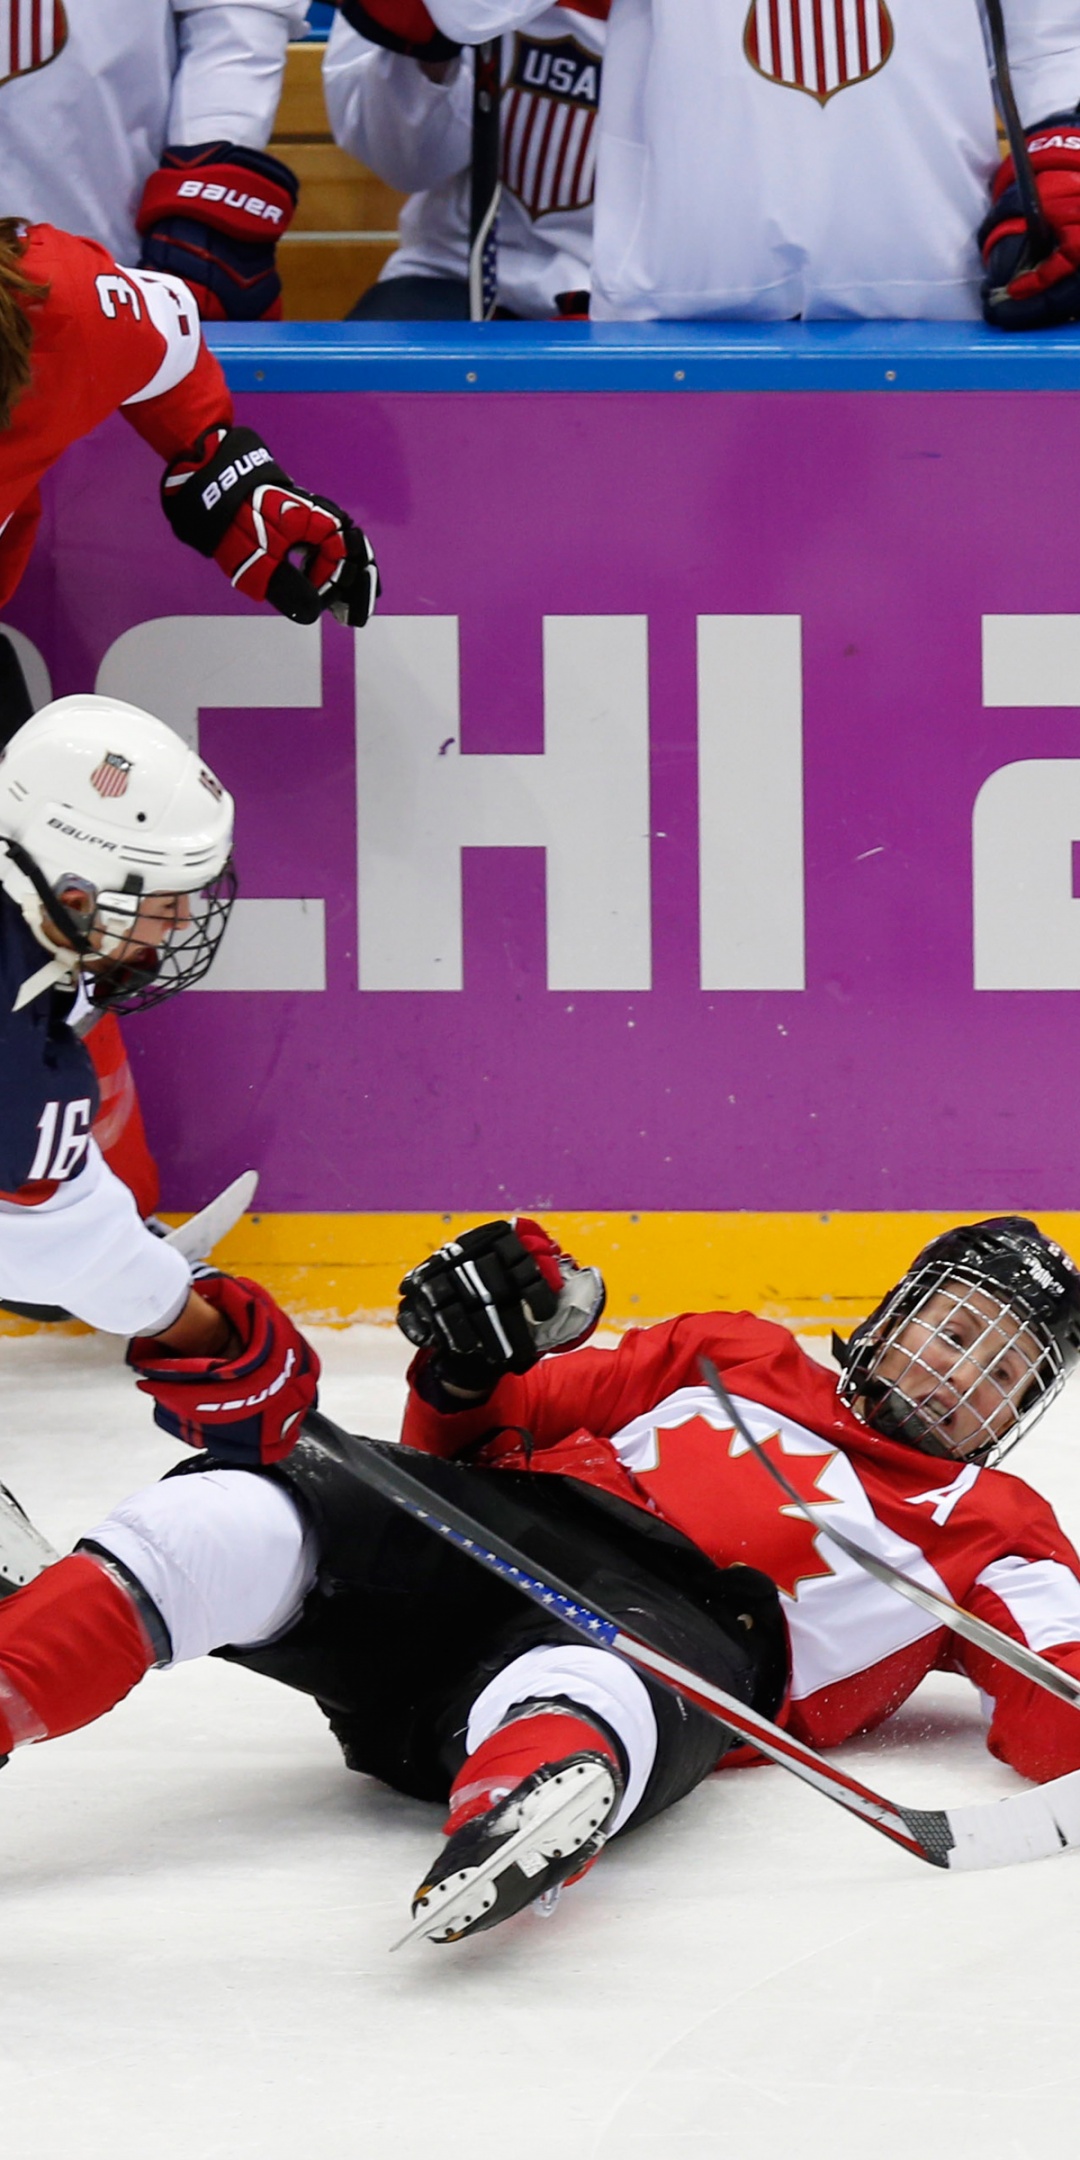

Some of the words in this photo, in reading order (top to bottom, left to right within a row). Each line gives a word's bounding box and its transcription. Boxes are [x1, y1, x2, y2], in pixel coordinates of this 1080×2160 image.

[523, 49, 596, 101] USA
[95, 274, 141, 321] 3
[0, 615, 805, 991] CHI
[27, 1097, 92, 1180] 16
[903, 1462, 987, 1527] A
